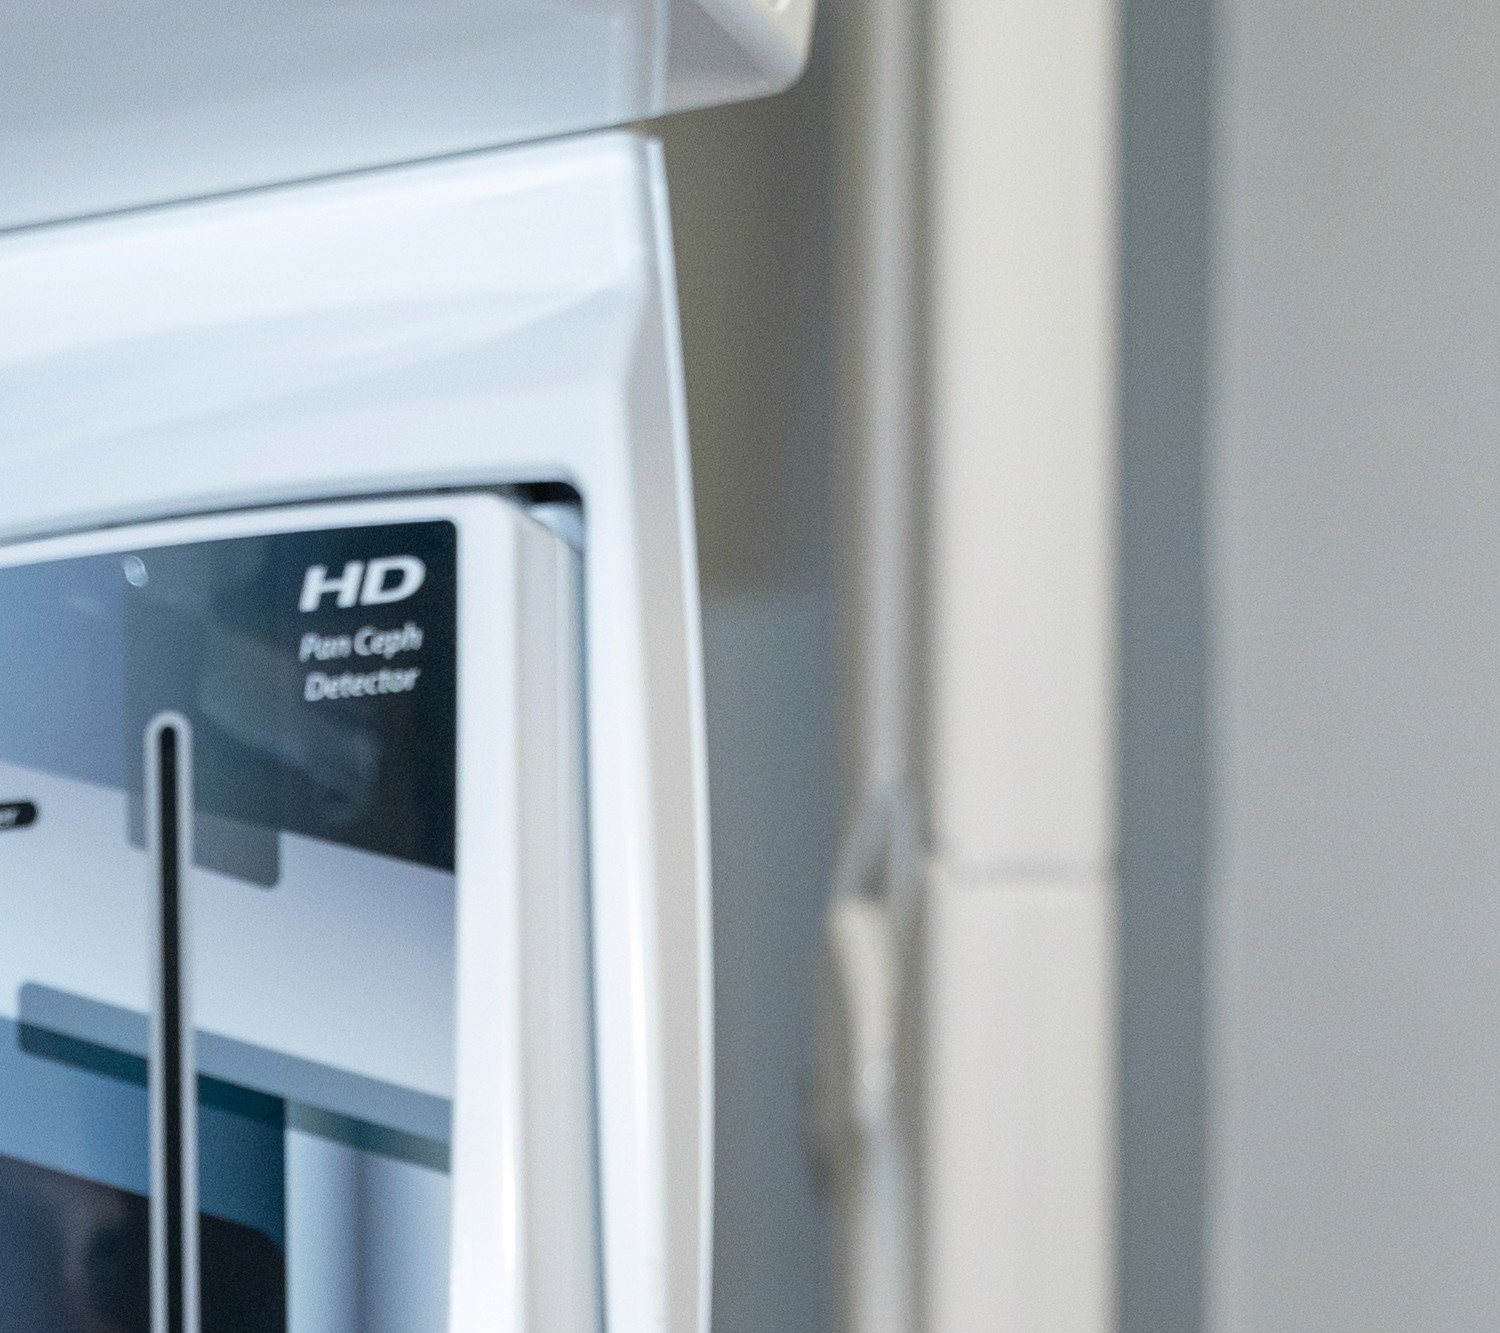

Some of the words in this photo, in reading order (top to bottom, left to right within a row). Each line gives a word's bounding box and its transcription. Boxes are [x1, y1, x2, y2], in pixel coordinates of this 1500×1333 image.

[298, 555, 426, 613] HD
[299, 632, 351, 662] Pan
[353, 621, 424, 660] Ceph
[304, 667, 421, 702] Detector
